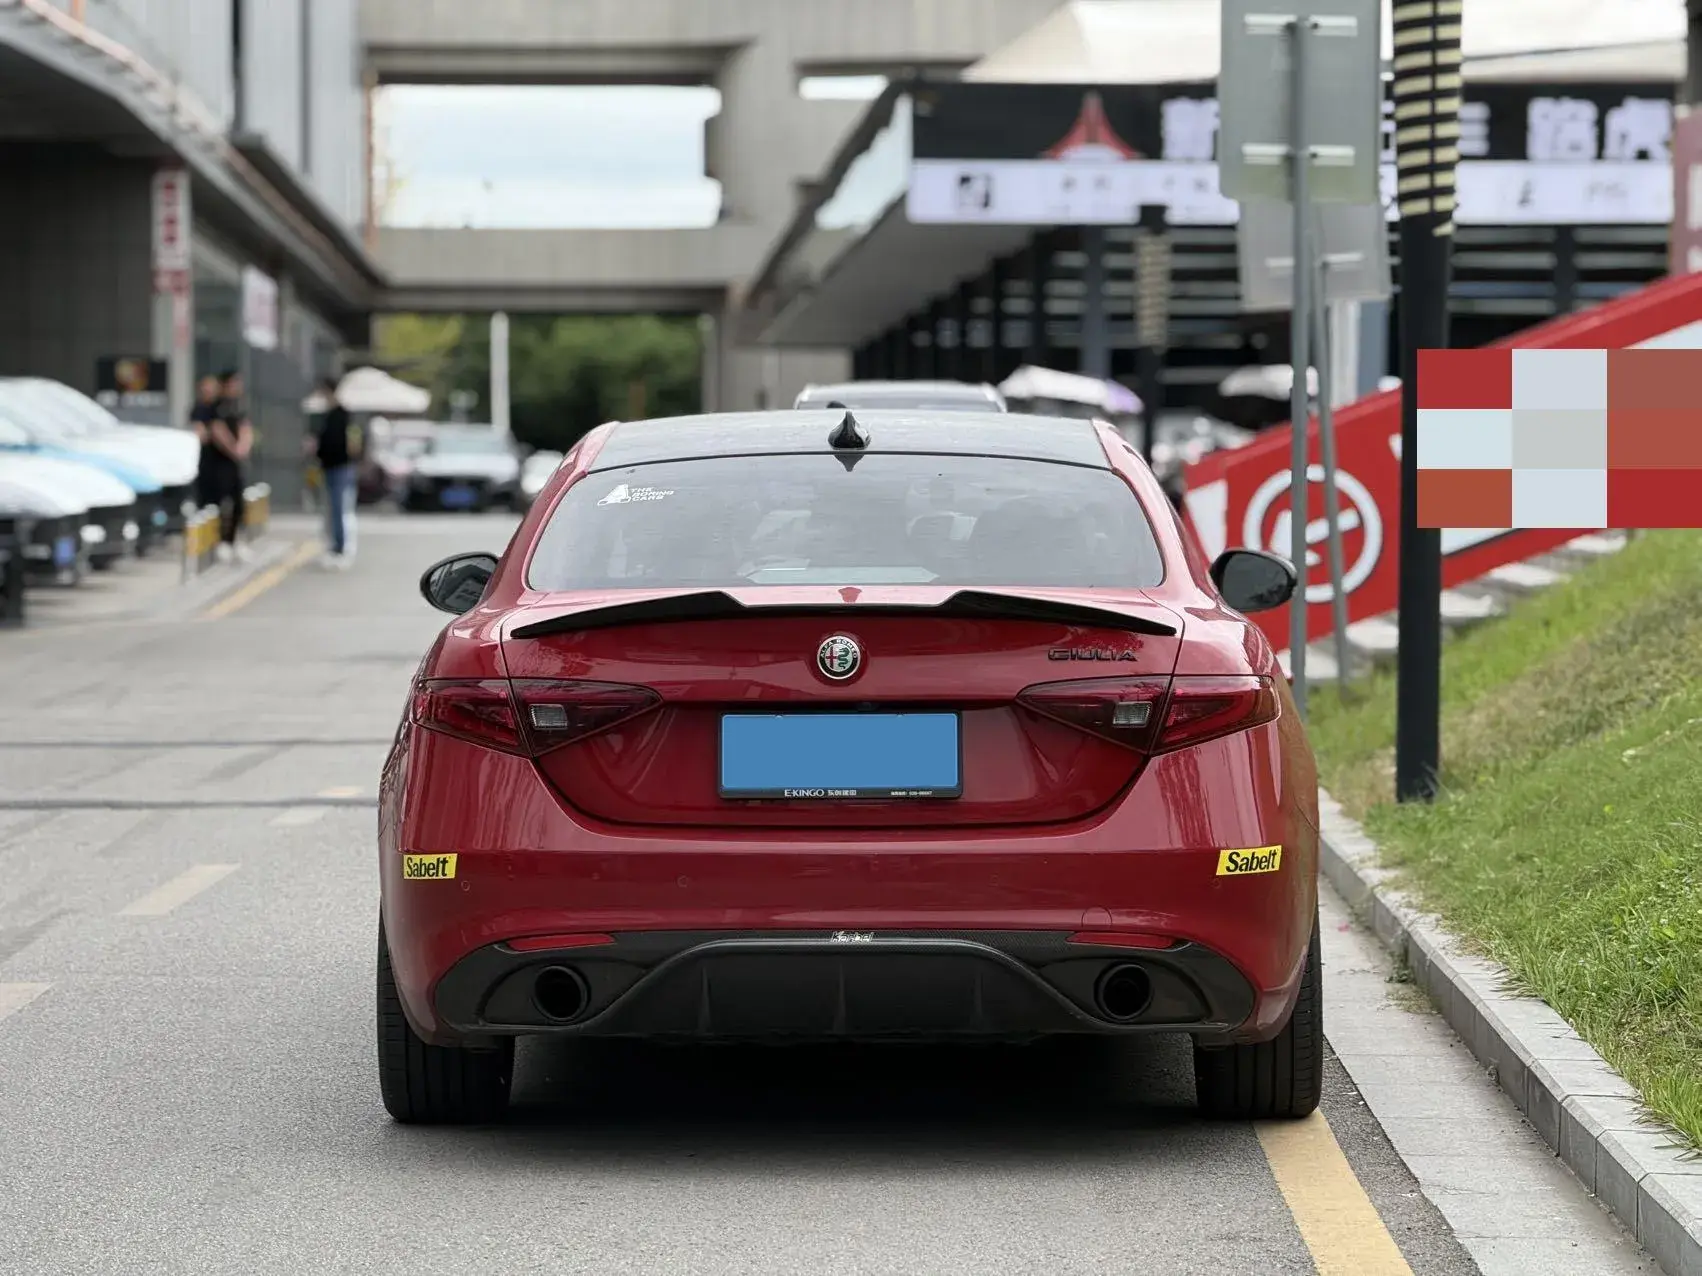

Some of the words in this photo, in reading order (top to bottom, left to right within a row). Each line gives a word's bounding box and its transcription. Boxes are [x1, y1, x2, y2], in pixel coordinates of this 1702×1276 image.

[1048, 648, 1138, 661] GIULIA
[406, 856, 449, 877] Sabelt
[1225, 849, 1277, 872] Sabelt
